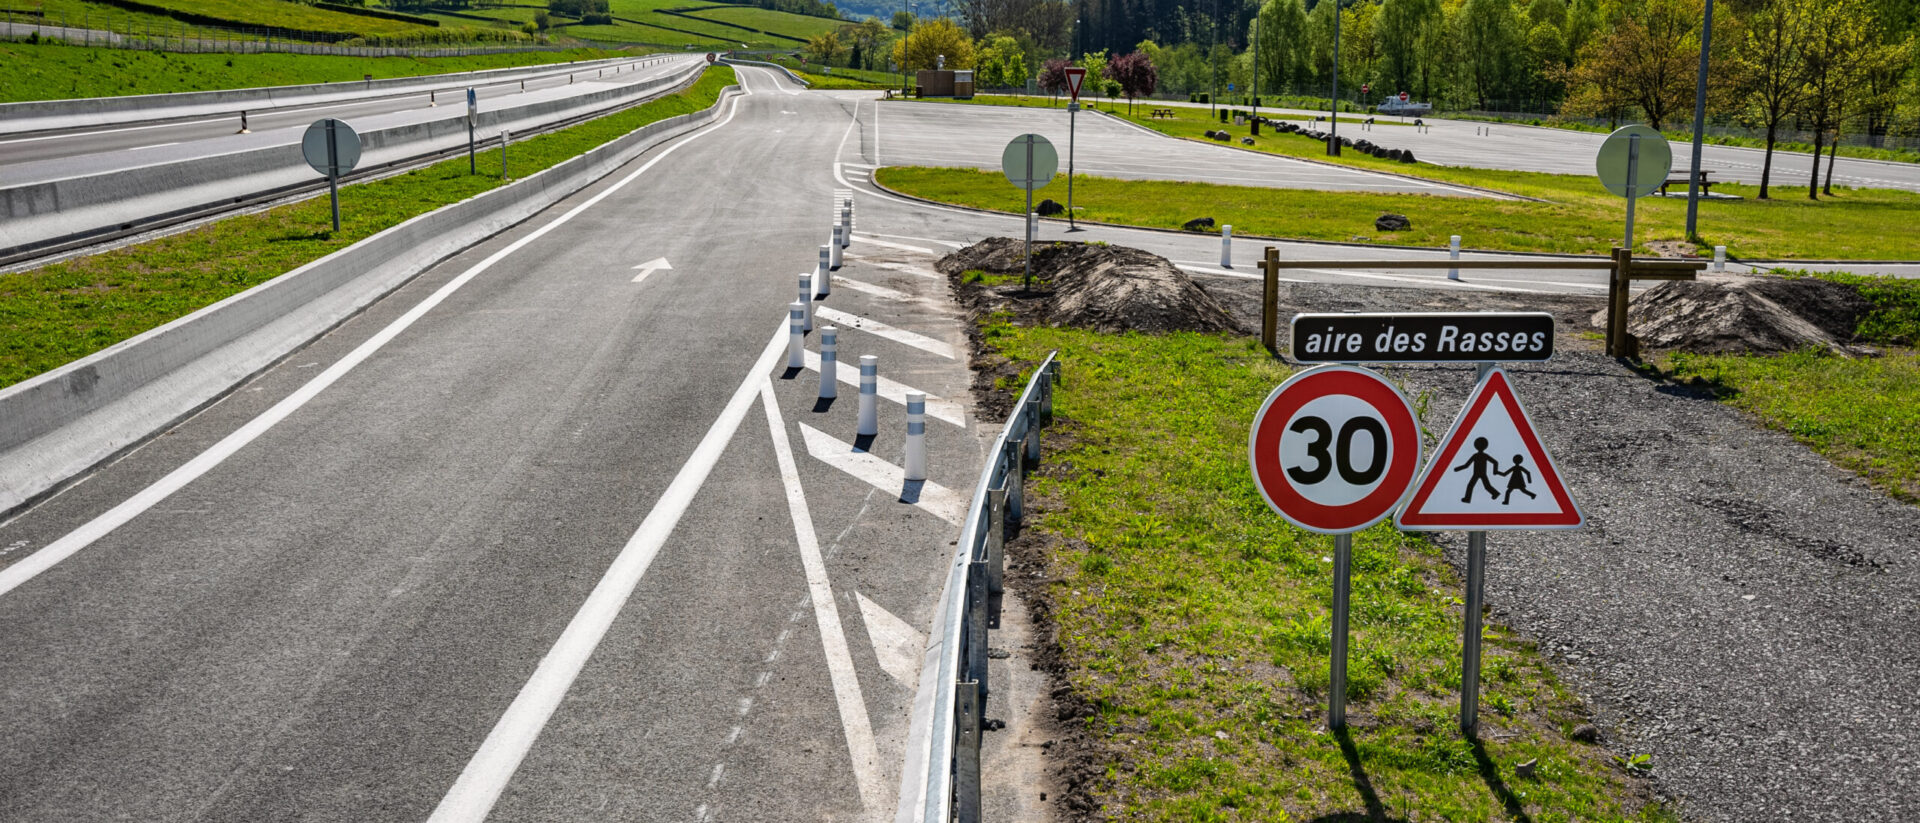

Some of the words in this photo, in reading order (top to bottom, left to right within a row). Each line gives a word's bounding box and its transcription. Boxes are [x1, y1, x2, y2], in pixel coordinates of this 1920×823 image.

[1305, 326, 1363, 353] aire
[1375, 326, 1427, 353] des
[1437, 325, 1546, 353] Rasses
[1286, 415, 1388, 486] 30
